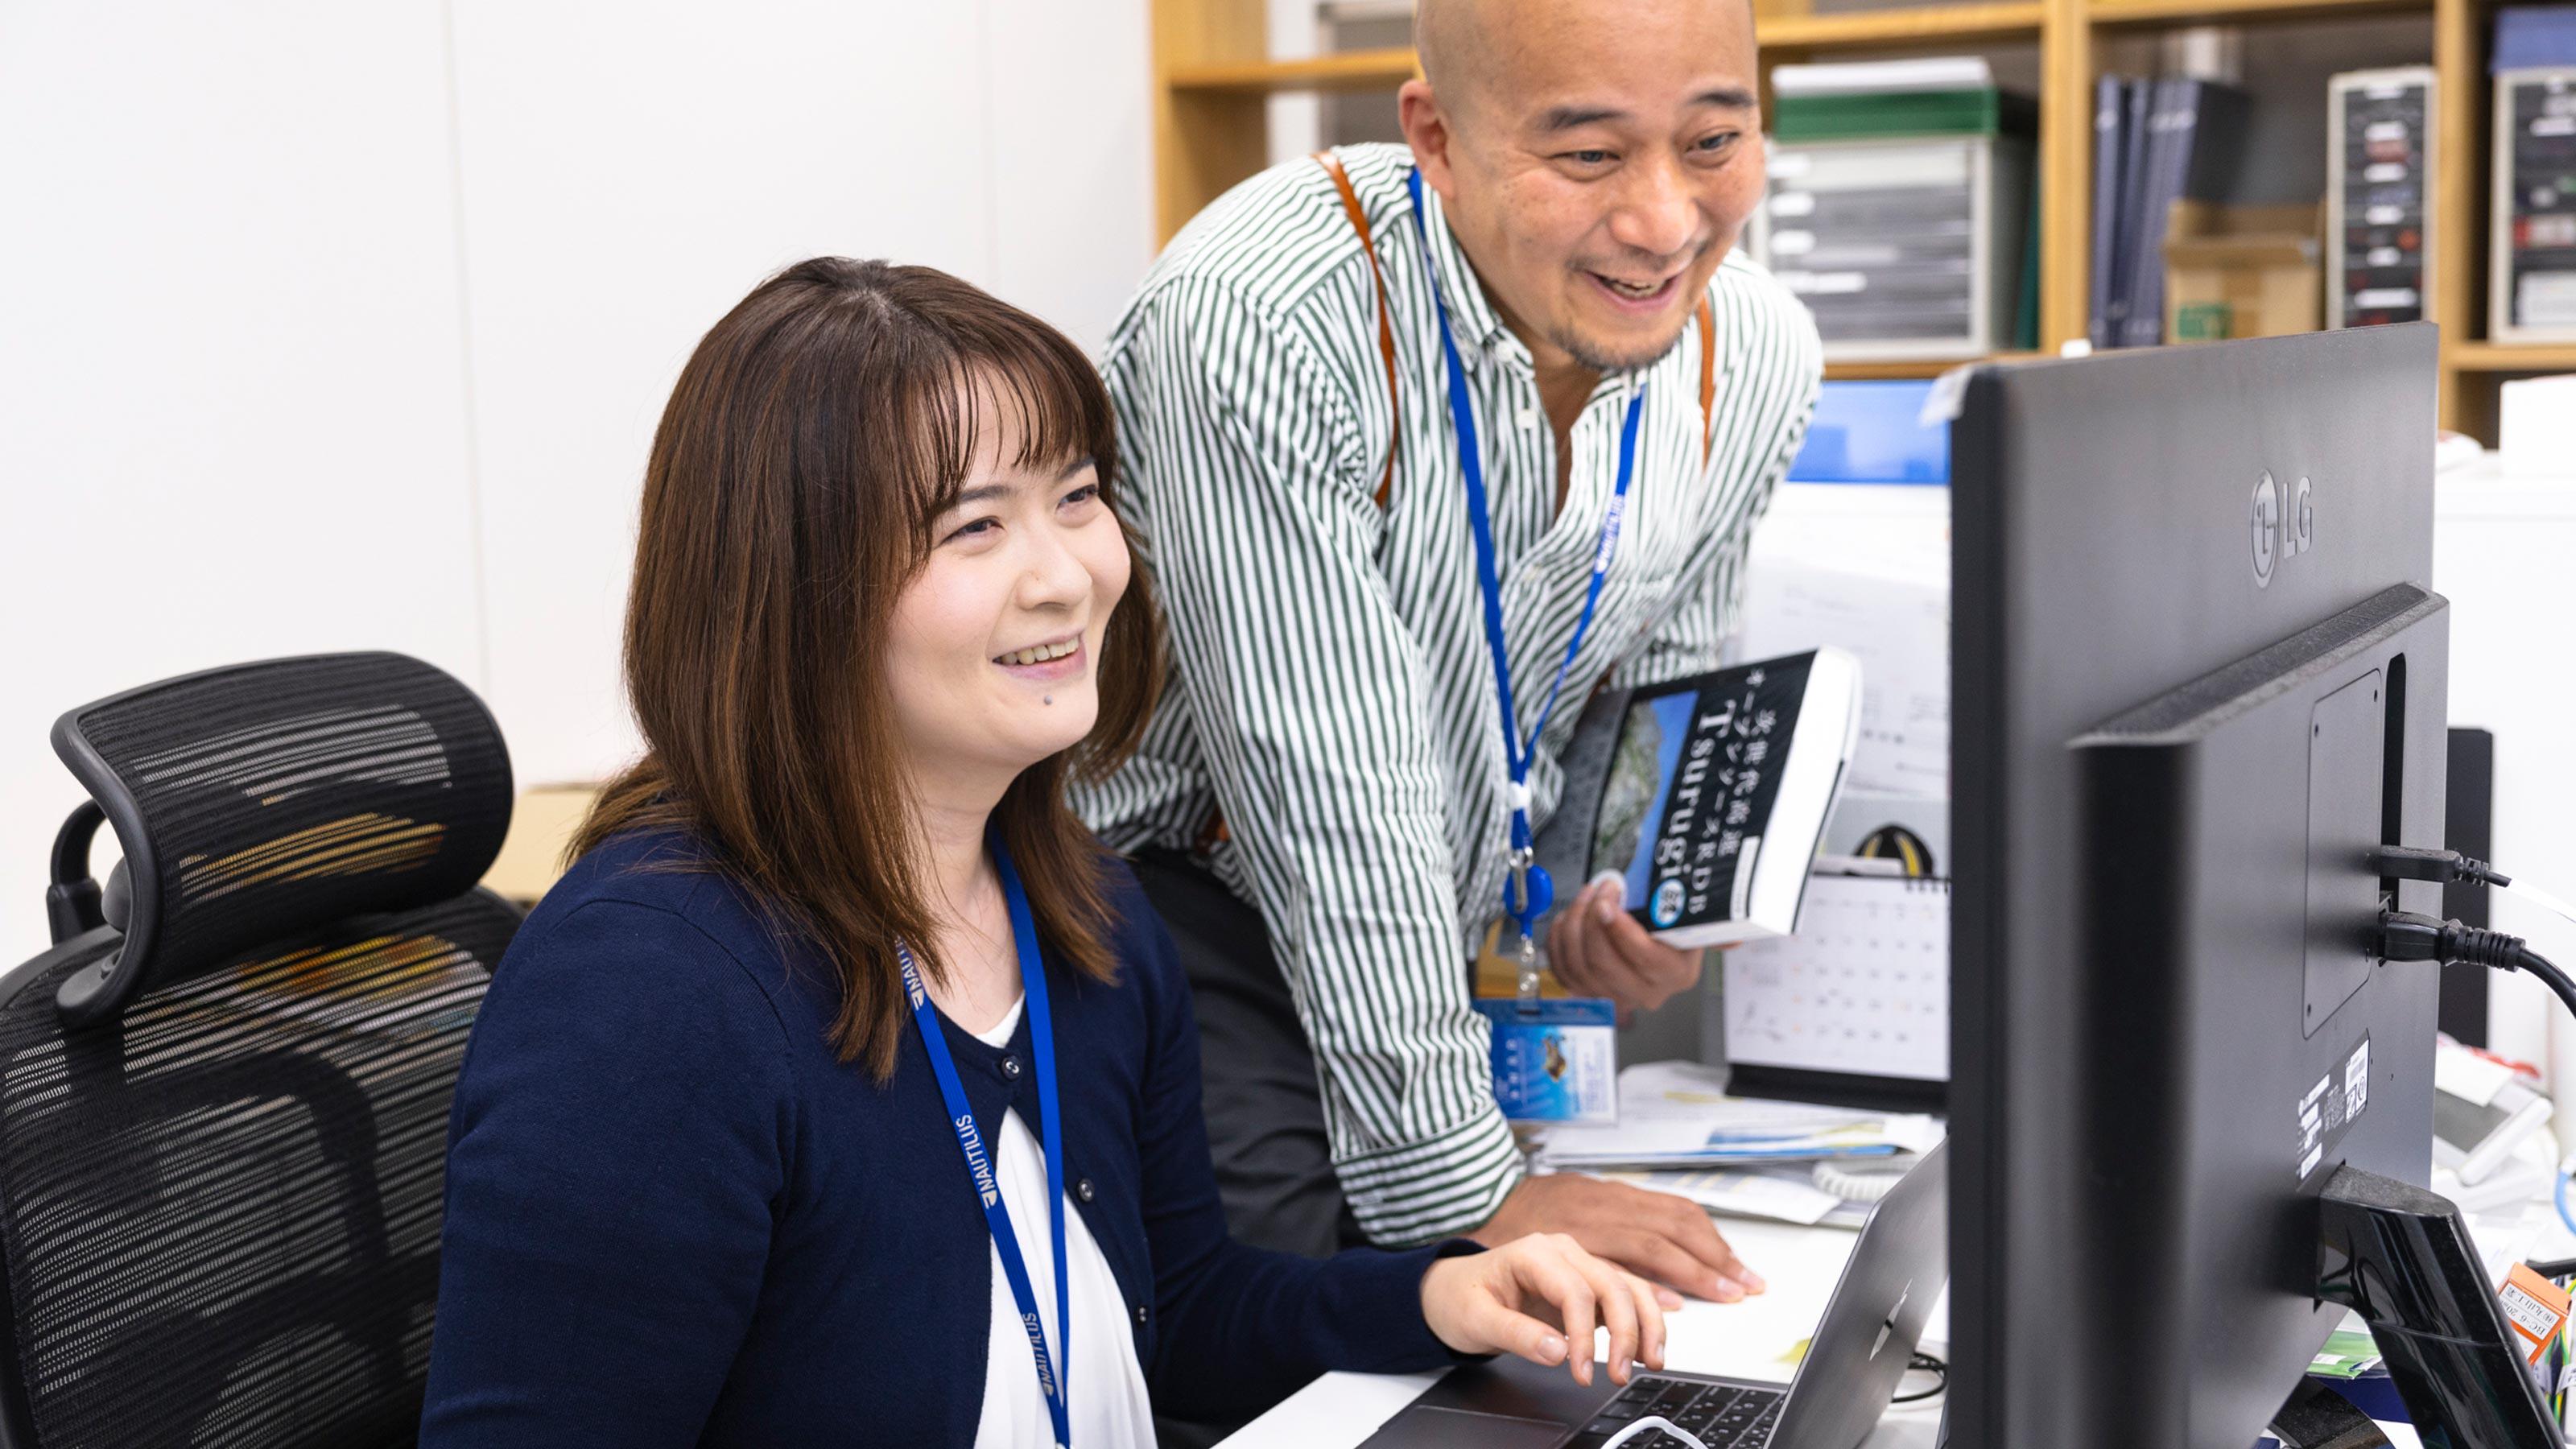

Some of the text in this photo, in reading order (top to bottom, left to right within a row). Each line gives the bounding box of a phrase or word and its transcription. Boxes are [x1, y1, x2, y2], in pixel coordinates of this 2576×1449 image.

[2283, 476, 2312, 559] LG
[1654, 699, 1737, 879] Tsurugi
[956, 1114, 996, 1191] NAUTILUS
[1022, 1312, 1053, 1386] NAUTILUS
[2520, 1315, 2545, 1335] BC-6
